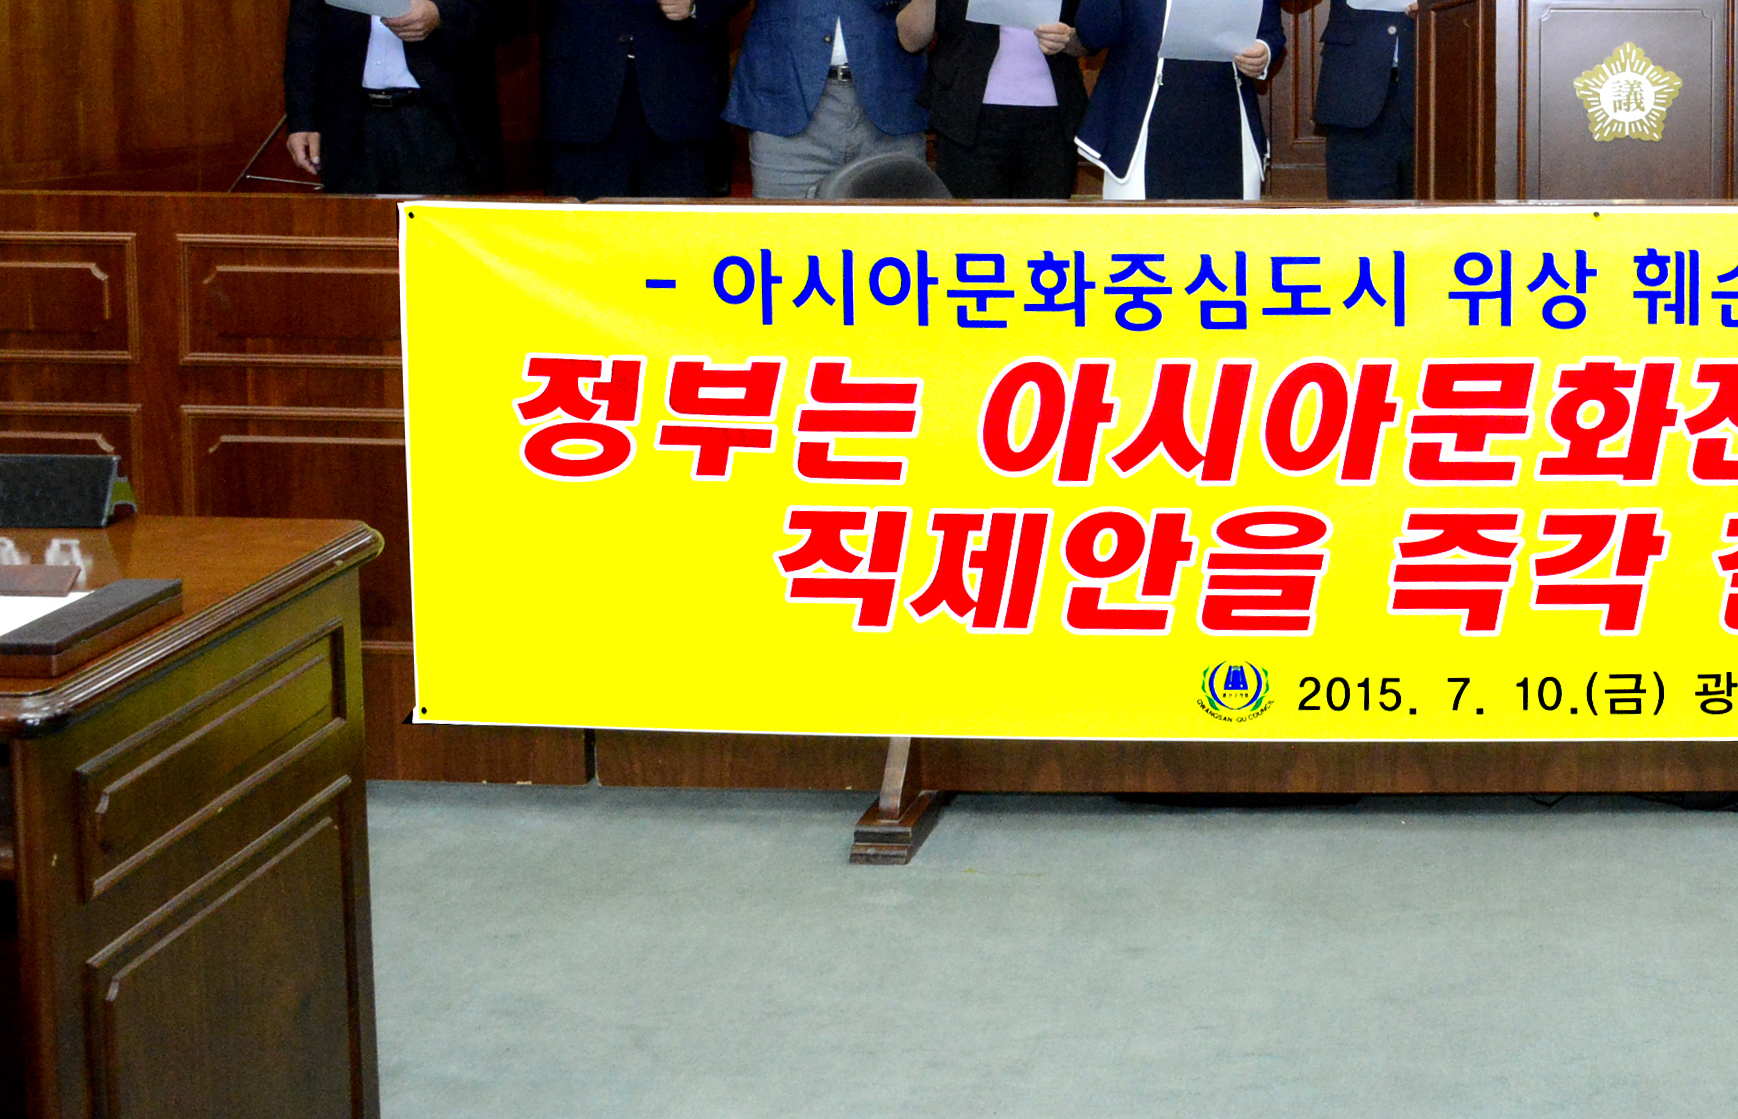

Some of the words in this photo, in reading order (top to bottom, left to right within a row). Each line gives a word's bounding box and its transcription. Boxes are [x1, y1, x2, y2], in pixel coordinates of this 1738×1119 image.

[714, 248, 1406, 332] 아시아문화중심도시
[1448, 249, 1598, 330] 위상
[514, 354, 921, 484] 정부는
[775, 507, 1330, 634] 직제안을
[1389, 509, 1668, 634] 즉각
[1298, 676, 1418, 715] 2015.
[1446, 677, 1485, 715] 7.
